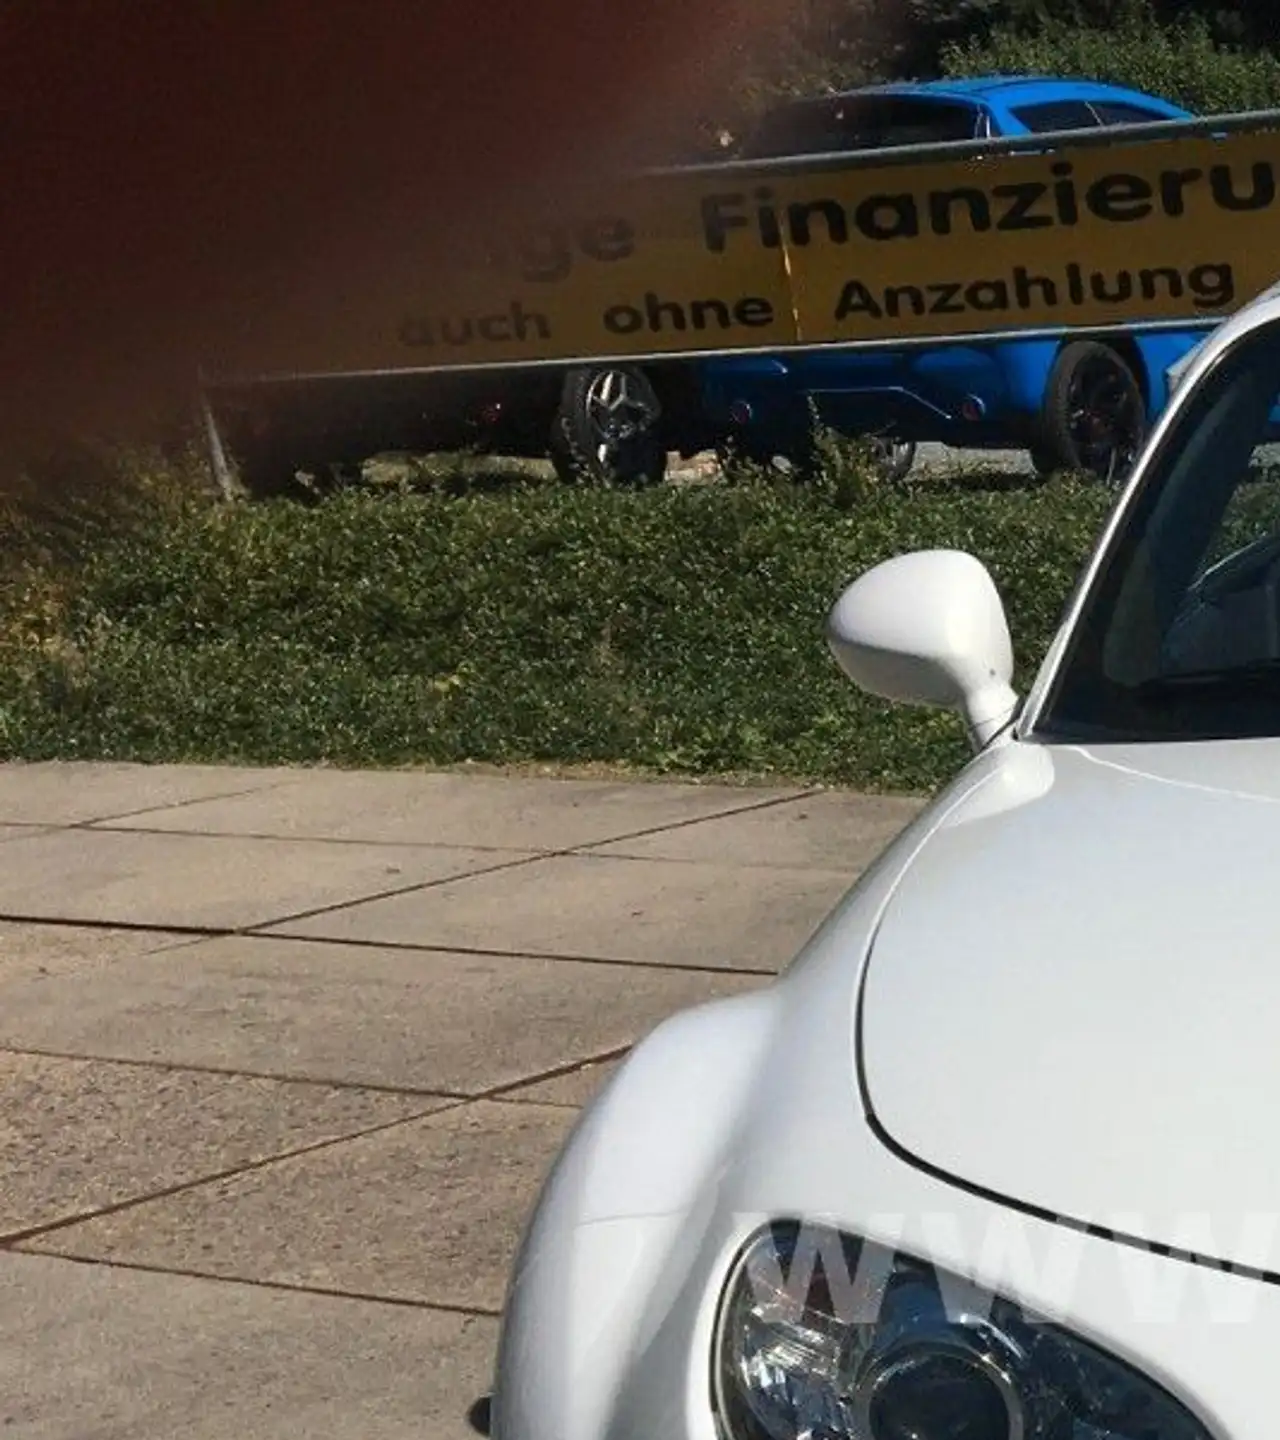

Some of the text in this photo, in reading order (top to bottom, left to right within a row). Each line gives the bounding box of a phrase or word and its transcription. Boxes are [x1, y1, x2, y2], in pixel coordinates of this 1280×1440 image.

[397, 257, 1235, 347] auch ohne Anzahlung
